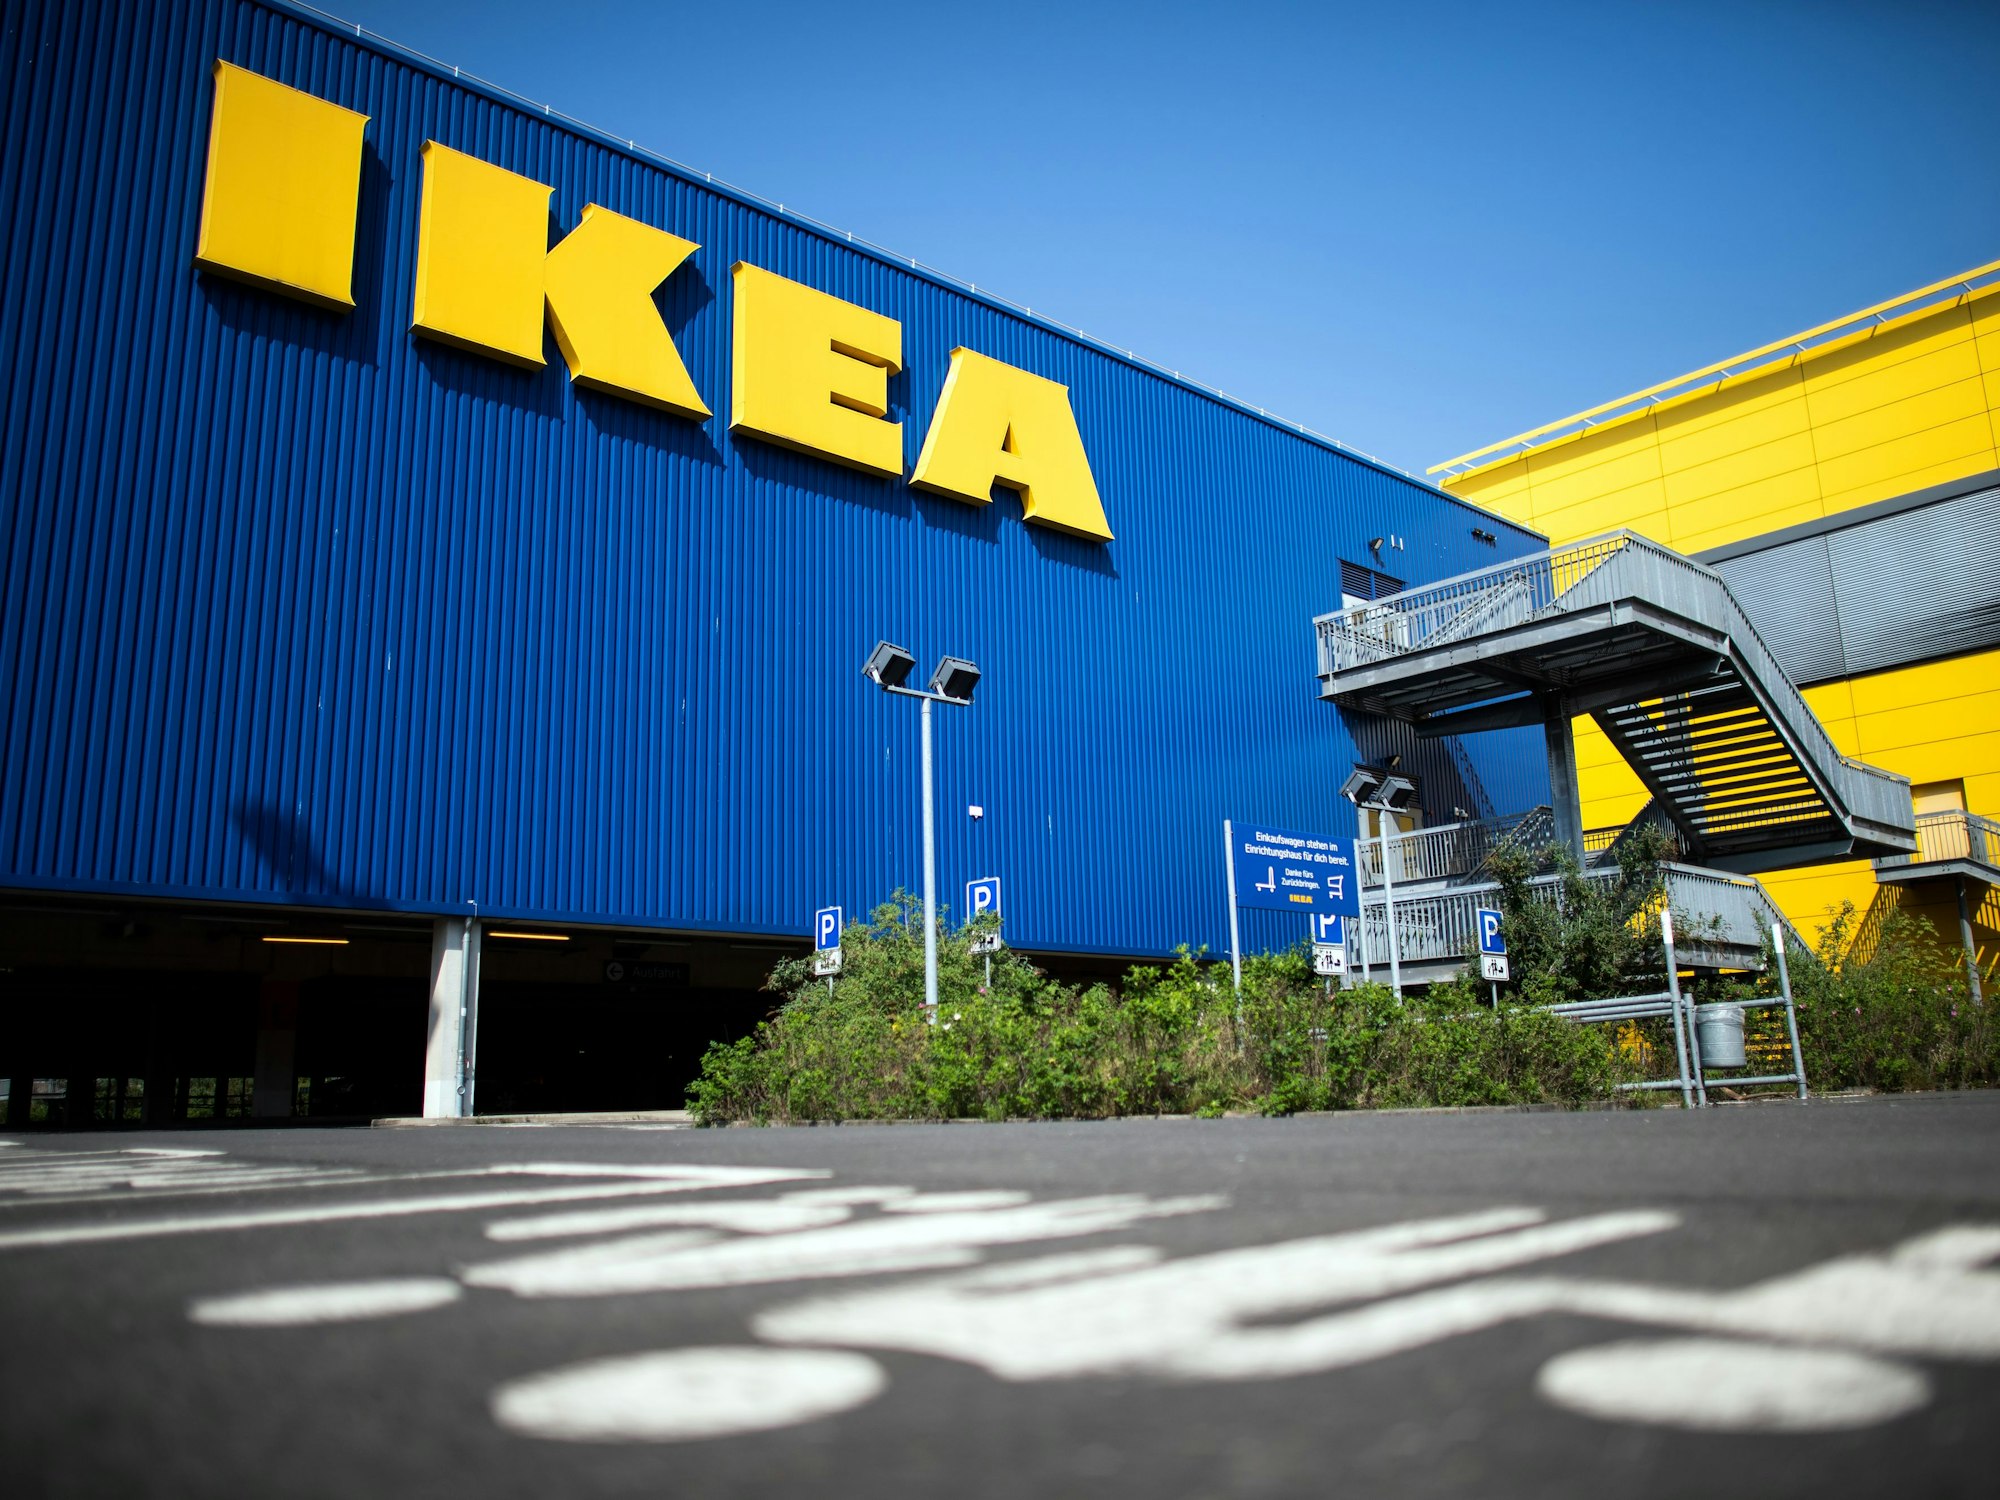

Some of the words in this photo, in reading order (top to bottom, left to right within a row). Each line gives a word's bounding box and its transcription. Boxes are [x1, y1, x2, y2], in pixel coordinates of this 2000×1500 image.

[195, 58, 1115, 542] IKEA
[1255, 832, 1305, 848] Einkaufswagen
[1306, 840, 1328, 850] stehen
[1329, 842, 1338, 852] im
[1245, 844, 1302, 860] Einrichtungshaus
[1303, 851, 1312, 861] für
[1314, 853, 1327, 863] dich
[1328, 855, 1349, 866] bereit.
[1285, 868, 1302, 877] Danke
[1302, 870, 1314, 878] fürs
[1281, 877, 1320, 890] Zurückbringen.
[1289, 894, 1313, 904] IKEA
[821, 914, 835, 946] P
[1484, 915, 1498, 948] P
[632, 966, 681, 979] Ausfahrt
